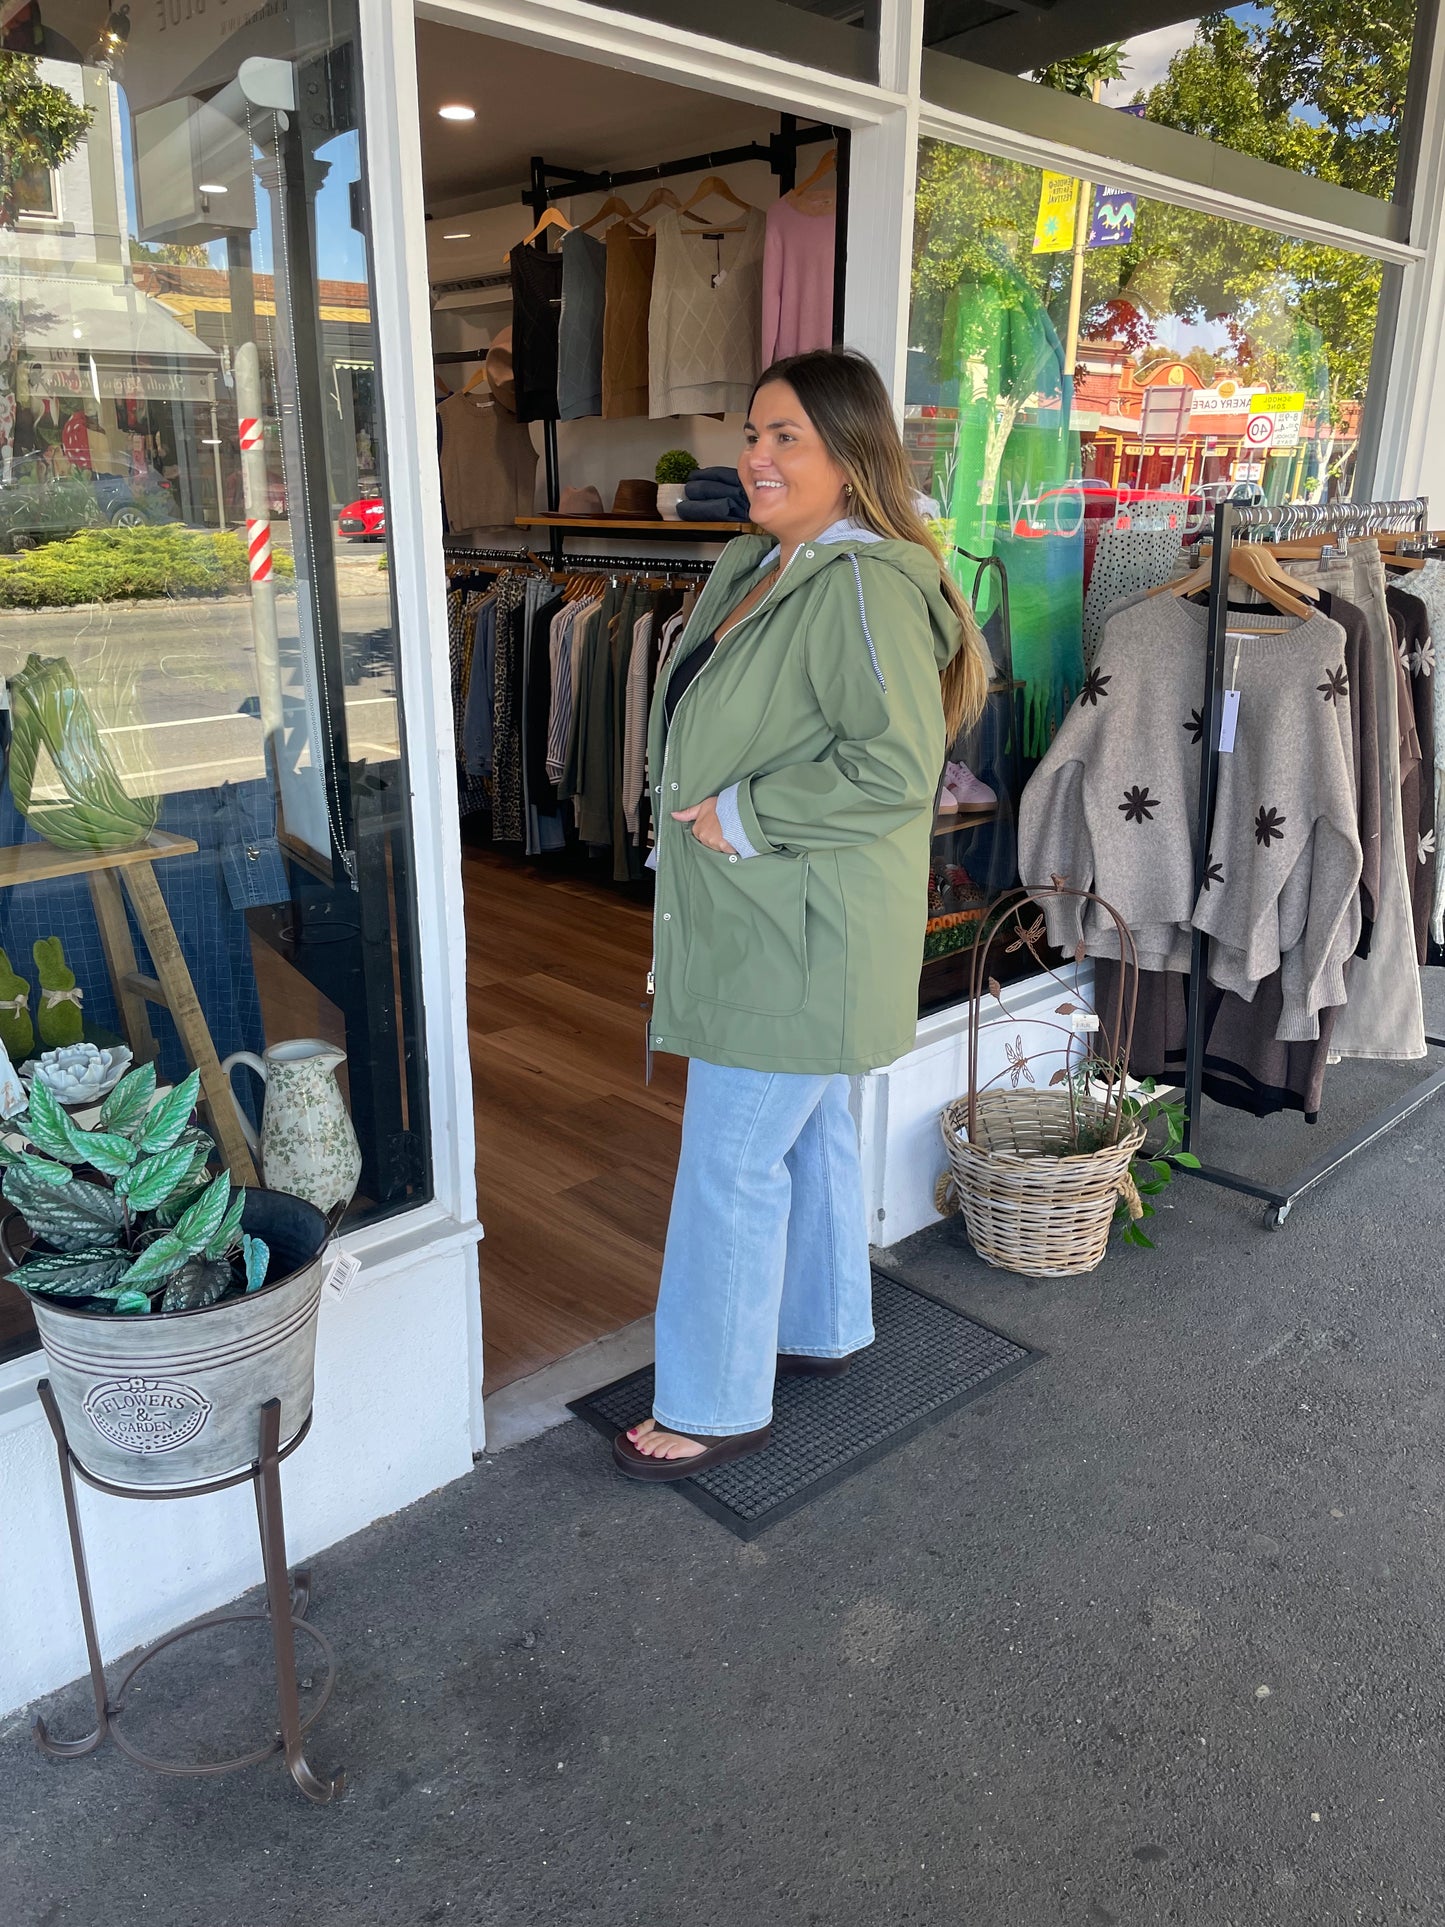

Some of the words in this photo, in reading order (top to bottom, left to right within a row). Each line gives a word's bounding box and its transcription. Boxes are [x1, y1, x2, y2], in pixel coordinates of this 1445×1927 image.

[100, 1394, 187, 1413] FLOWERS
[136, 1408, 153, 1422] &
[118, 1421, 174, 1433] GARDEN
